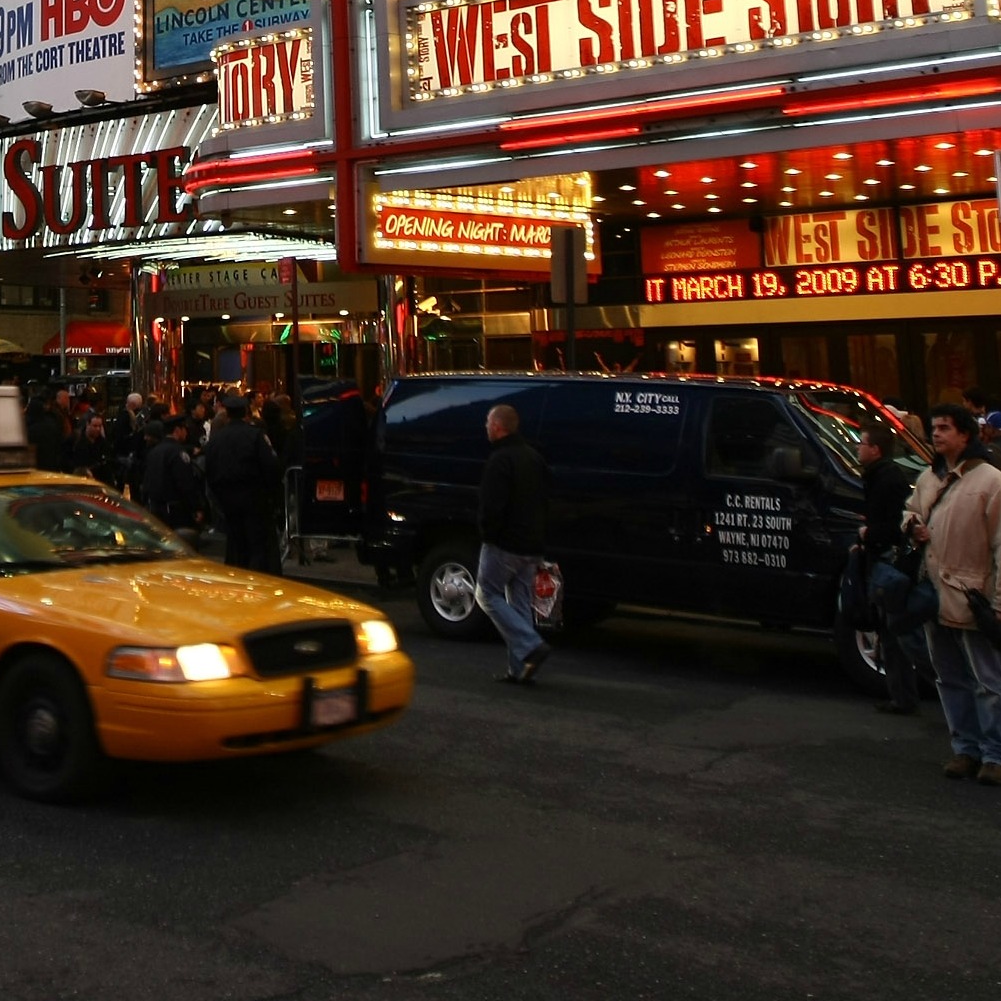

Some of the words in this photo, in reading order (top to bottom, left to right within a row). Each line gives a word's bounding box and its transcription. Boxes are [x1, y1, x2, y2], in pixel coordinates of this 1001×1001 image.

[156, 2, 230, 35] LINCOLN
[183, 29, 214, 46] TAKE
[216, 23, 239, 38] THE
[17, 53, 33, 79] THE
[35, 43, 65, 73] CORT
[68, 31, 125, 65] THEATRE
[2, 139, 200, 241] SUITE
[386, 214, 453, 239] OPENING
[458, 220, 507, 242] NIGHT:
[765, 211, 846, 266] WEST
[209, 268, 248, 282] STAGE
[671, 274, 745, 301] MARCH
[752, 272, 786, 298] 19,
[795, 267, 859, 296] 2009
[866, 265, 899, 293] AT
[909, 261, 970, 290] 6:30
[233, 291, 279, 310] GUEST
[283, 290, 336, 309] SUITES
[615, 391, 632, 404] N.Y.
[636, 392, 663, 405] CITY
[726, 493, 743, 509] C.C.
[744, 494, 781, 511] RENTALS
[714, 512, 736, 527] 1241
[737, 513, 750, 529] RT.
[752, 515, 763, 529] 23
[765, 516, 792, 531] SOUTH
[718, 530, 749, 548] WAYNE,
[762, 534, 790, 550] 07470
[723, 550, 740, 564] 973
